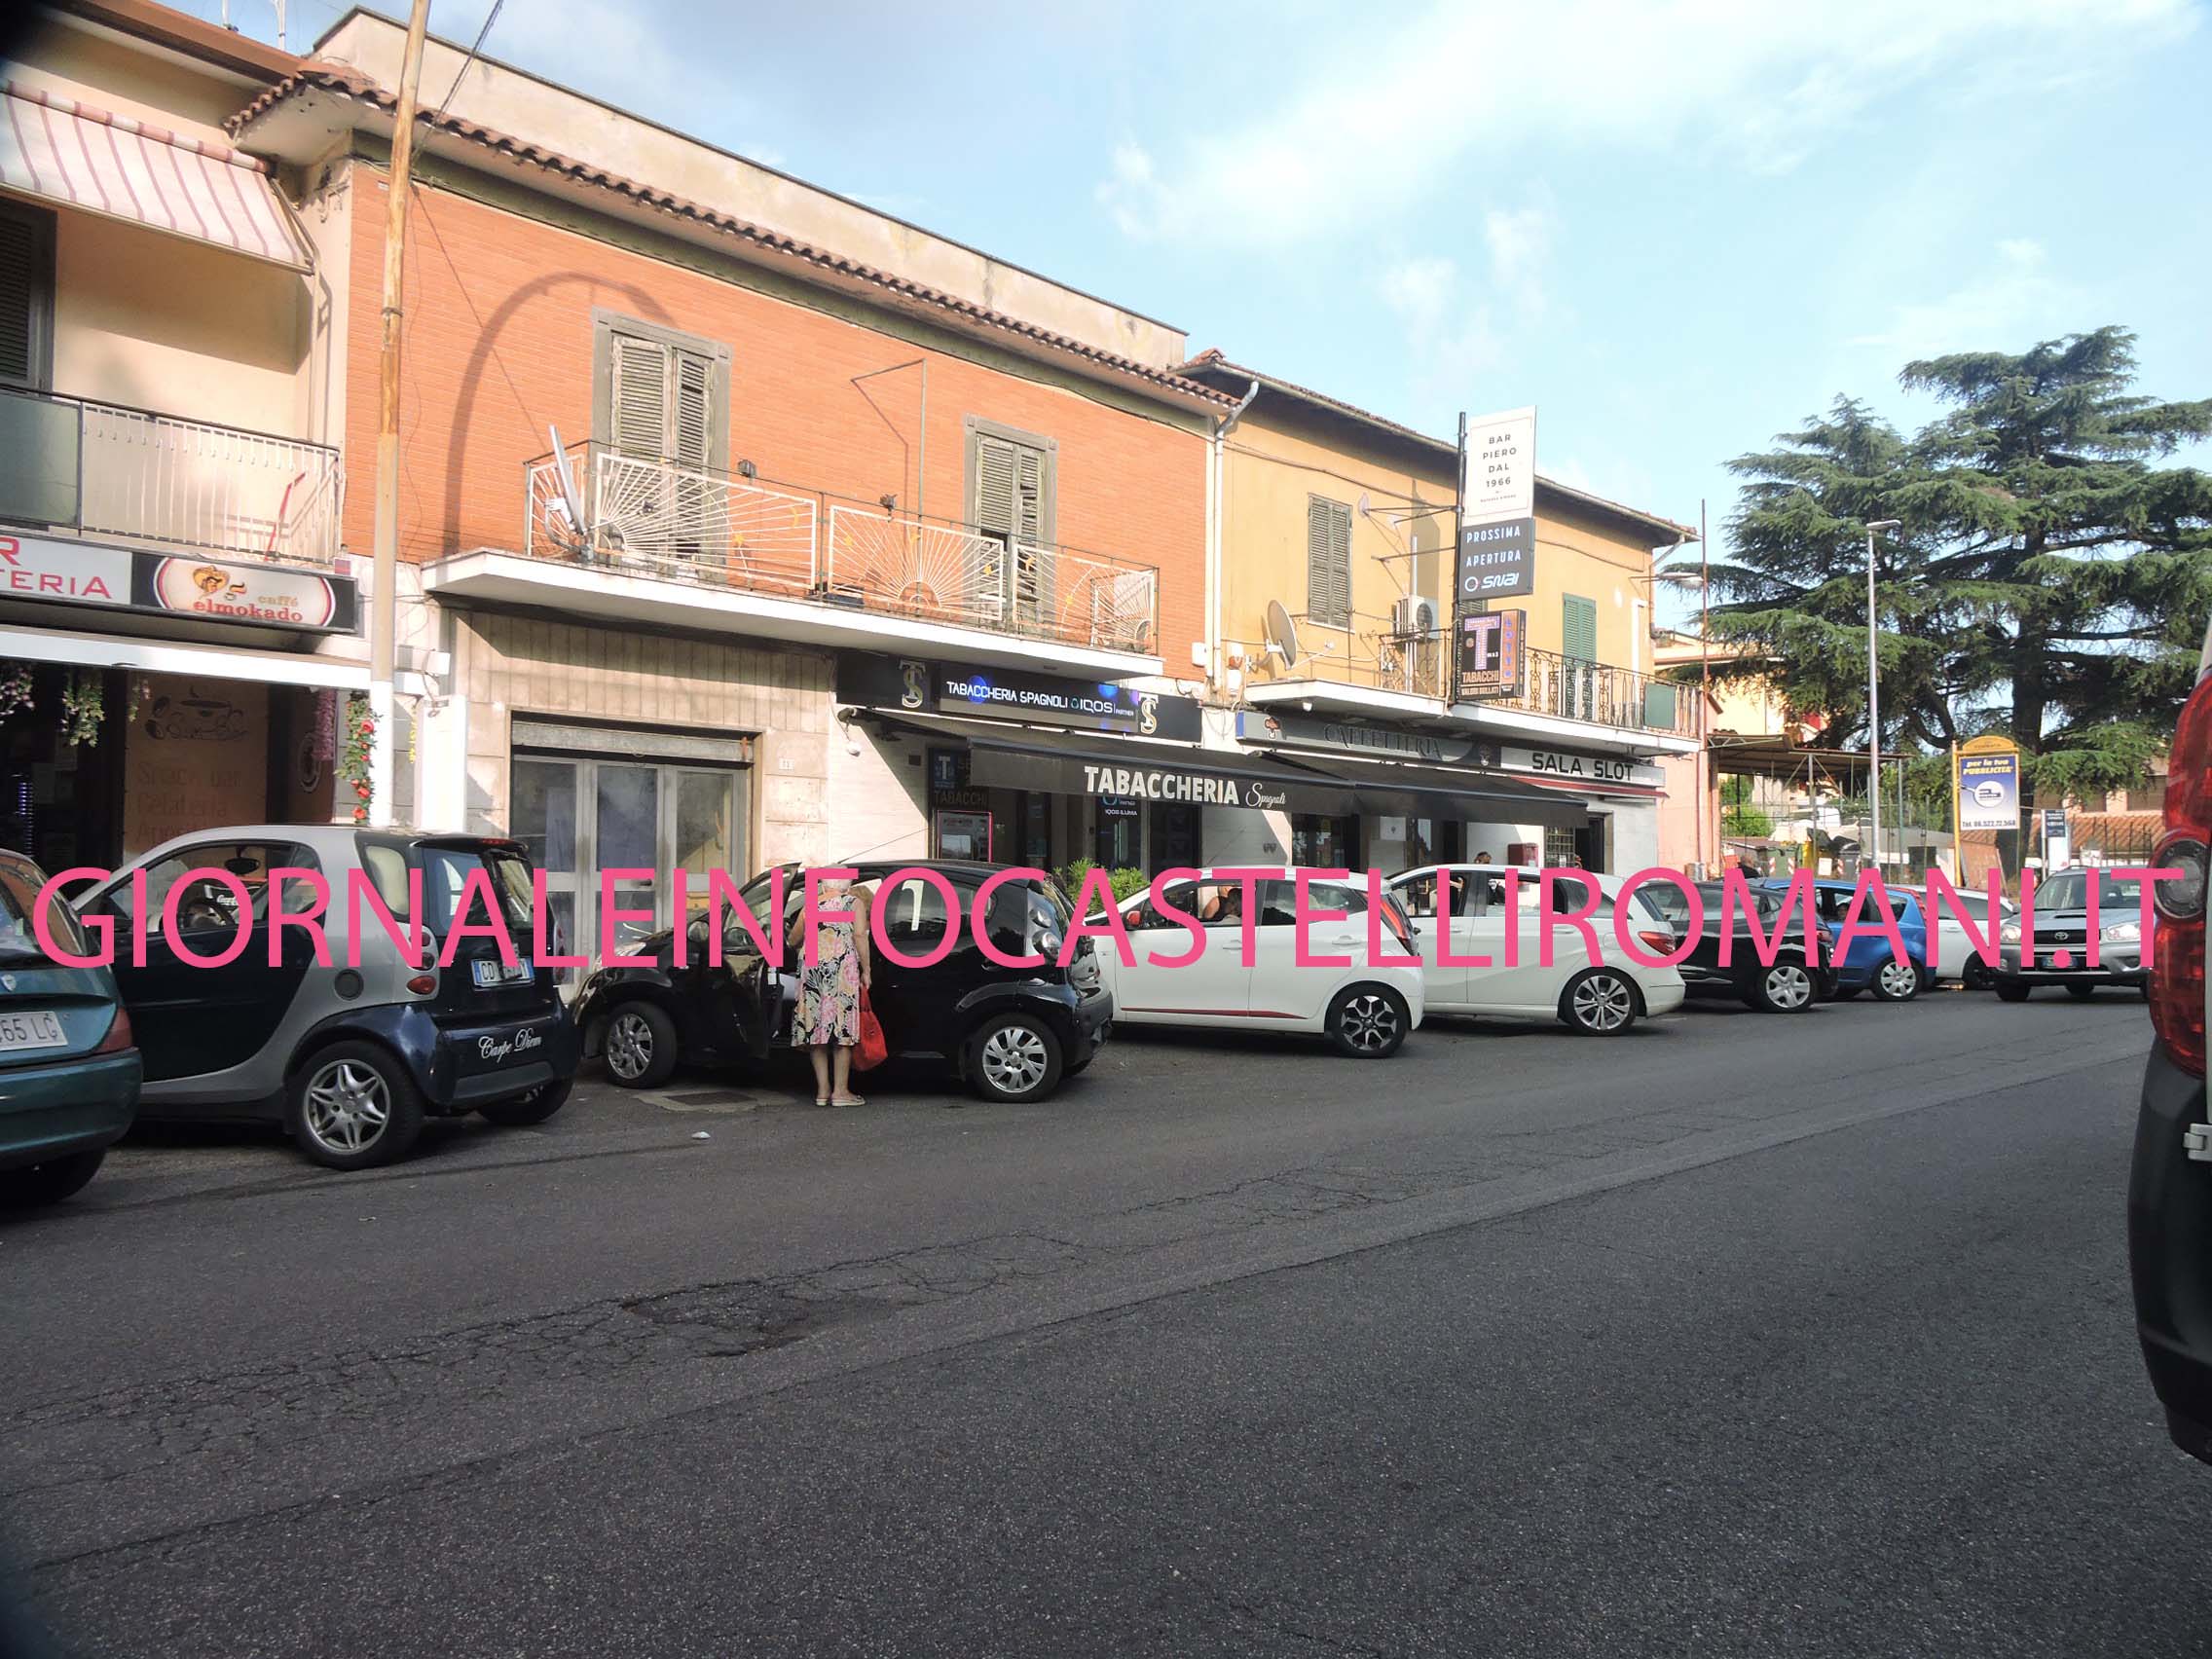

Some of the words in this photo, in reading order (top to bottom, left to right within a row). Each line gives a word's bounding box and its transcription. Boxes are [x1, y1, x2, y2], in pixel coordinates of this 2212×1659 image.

[1488, 434, 1511, 445] BAR
[1483, 447, 1517, 460] PIERO
[1488, 463, 1510, 473] DAL
[1486, 477, 1511, 488] 1966
[1466, 525, 1521, 543] PROSSIMA
[1465, 549, 1522, 568] APERTURA
[0, 569, 112, 600] ERIA
[194, 598, 303, 623] elmokado
[1461, 670, 1499, 683] TABACCHI
[946, 681, 1017, 702] TABACCHERIA
[1019, 690, 1068, 709] SPAGNOLI
[1080, 699, 1113, 714] IQOS
[1531, 753, 1583, 775] SALA
[1594, 760, 1634, 781] SLOT
[1084, 765, 1239, 805] TABACCHERIA
[0, 1018, 28, 1043] 65
[478, 1036, 512, 1063] Carpe
[514, 1027, 541, 1051] Diem
